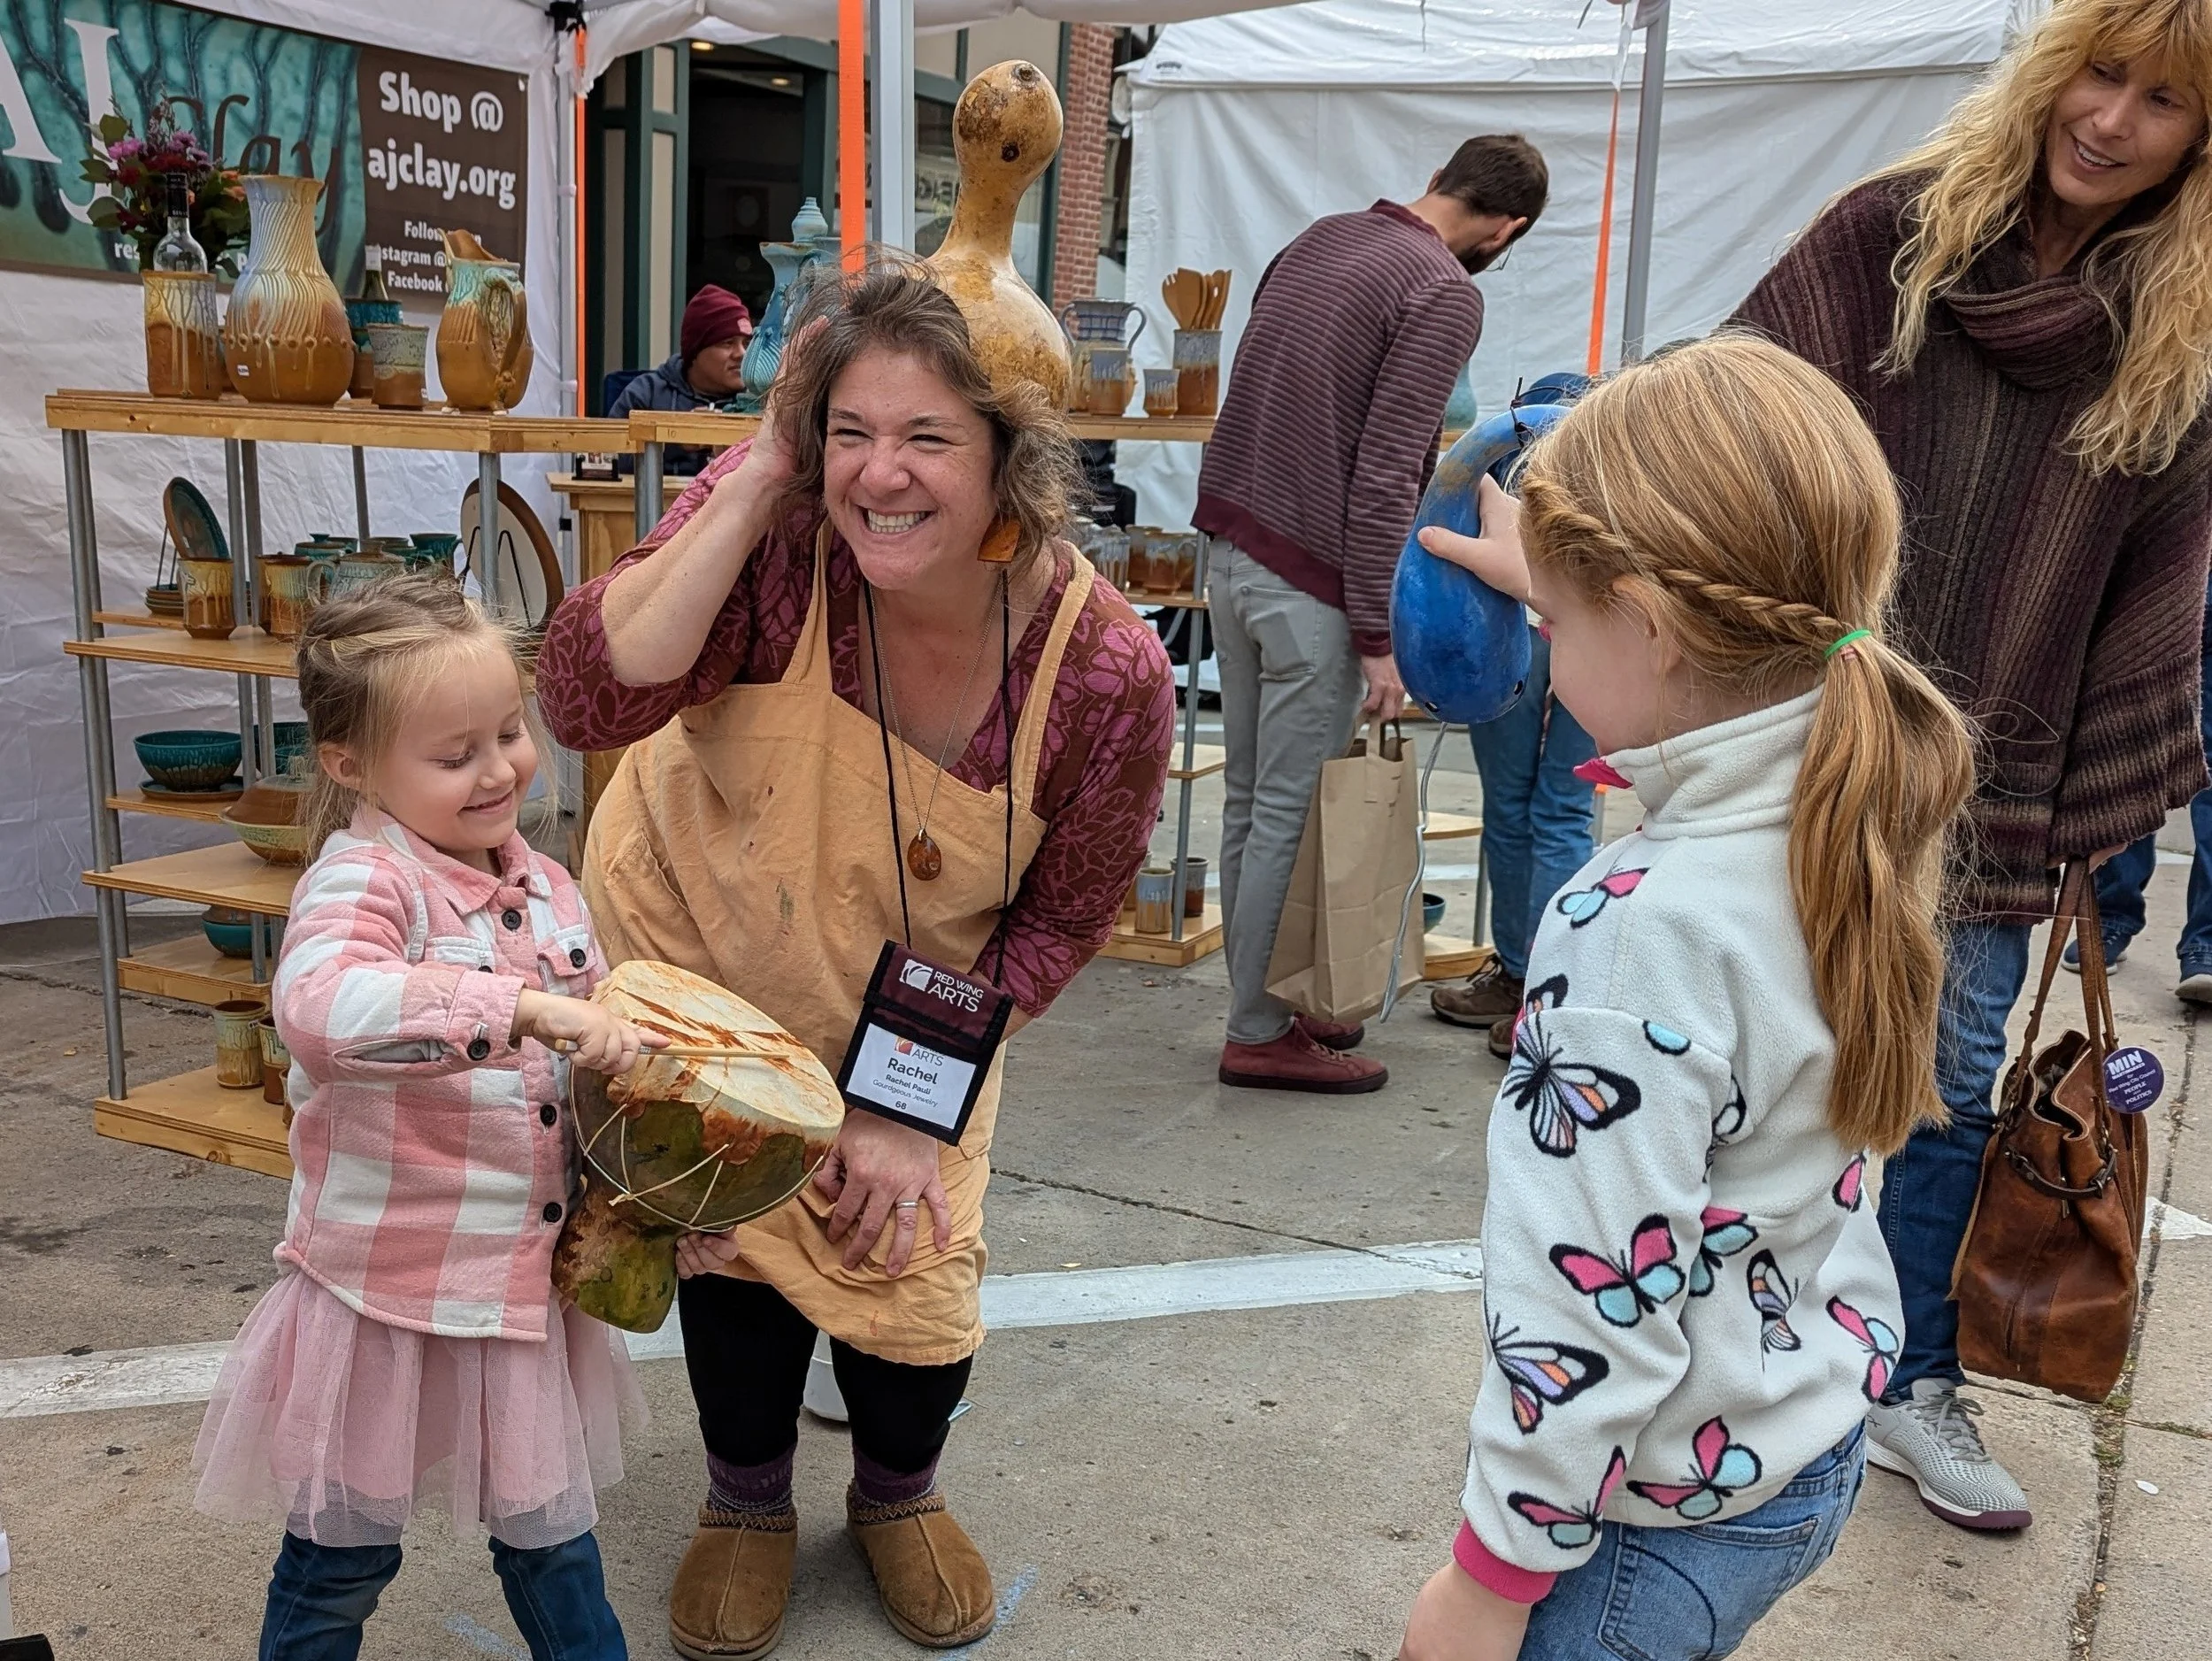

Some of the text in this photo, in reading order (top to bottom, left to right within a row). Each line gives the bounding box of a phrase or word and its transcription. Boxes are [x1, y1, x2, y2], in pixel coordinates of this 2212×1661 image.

[379, 71, 503, 133] Shop @
[368, 138, 517, 210] ajclay.org
[381, 246, 431, 266] stagram
[388, 270, 442, 292] Facebook
[927, 982, 979, 1012] ARTS
[933, 972, 984, 999] RED WING
[911, 1048, 944, 1066] ARTS
[2107, 1050, 2143, 1075] MIN
[886, 1073, 911, 1088] Rachel
[887, 1057, 938, 1085] Rachel
[895, 1100, 907, 1110] 68
[2125, 1089, 2153, 1105] POLITICS
